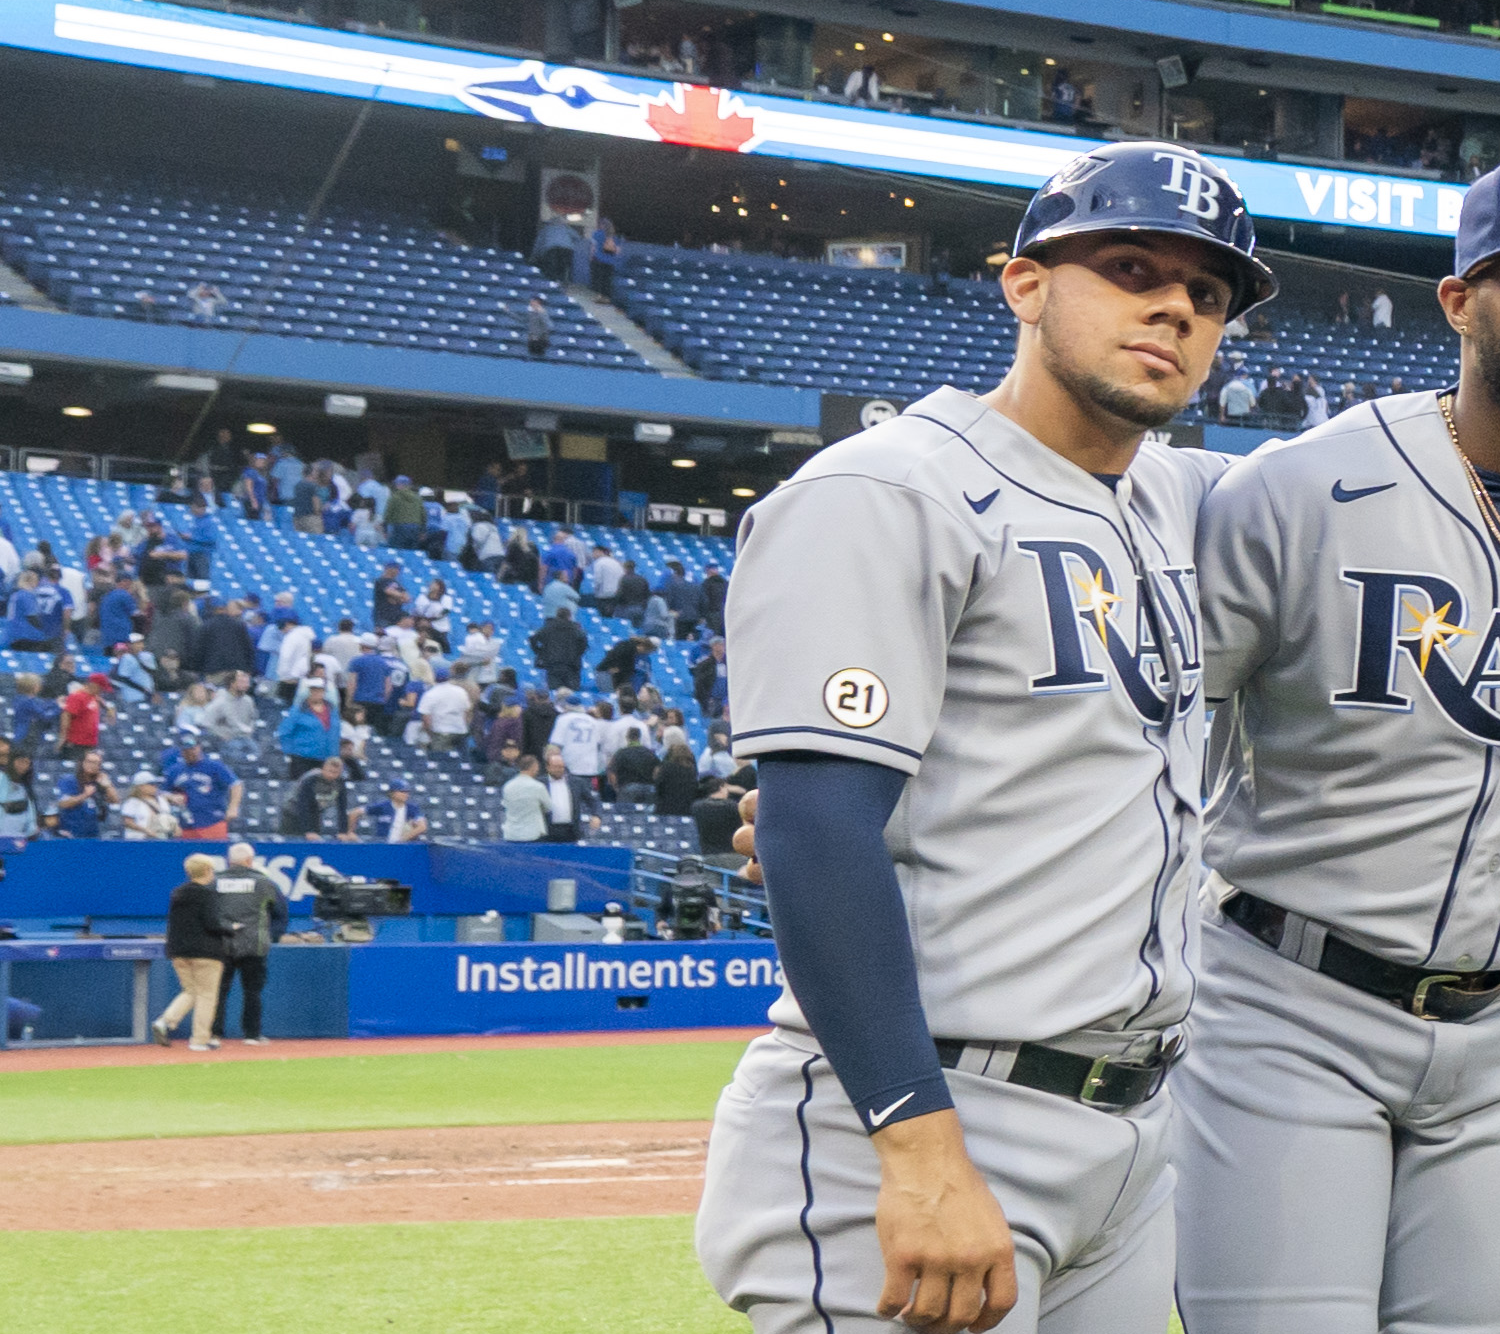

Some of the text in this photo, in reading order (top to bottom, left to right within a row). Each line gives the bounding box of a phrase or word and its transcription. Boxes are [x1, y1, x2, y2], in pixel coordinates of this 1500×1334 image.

[1153, 152, 1220, 221] TB
[1295, 171, 1424, 227] VISIT
[838, 680, 875, 715] 21
[457, 952, 717, 992] Installments
